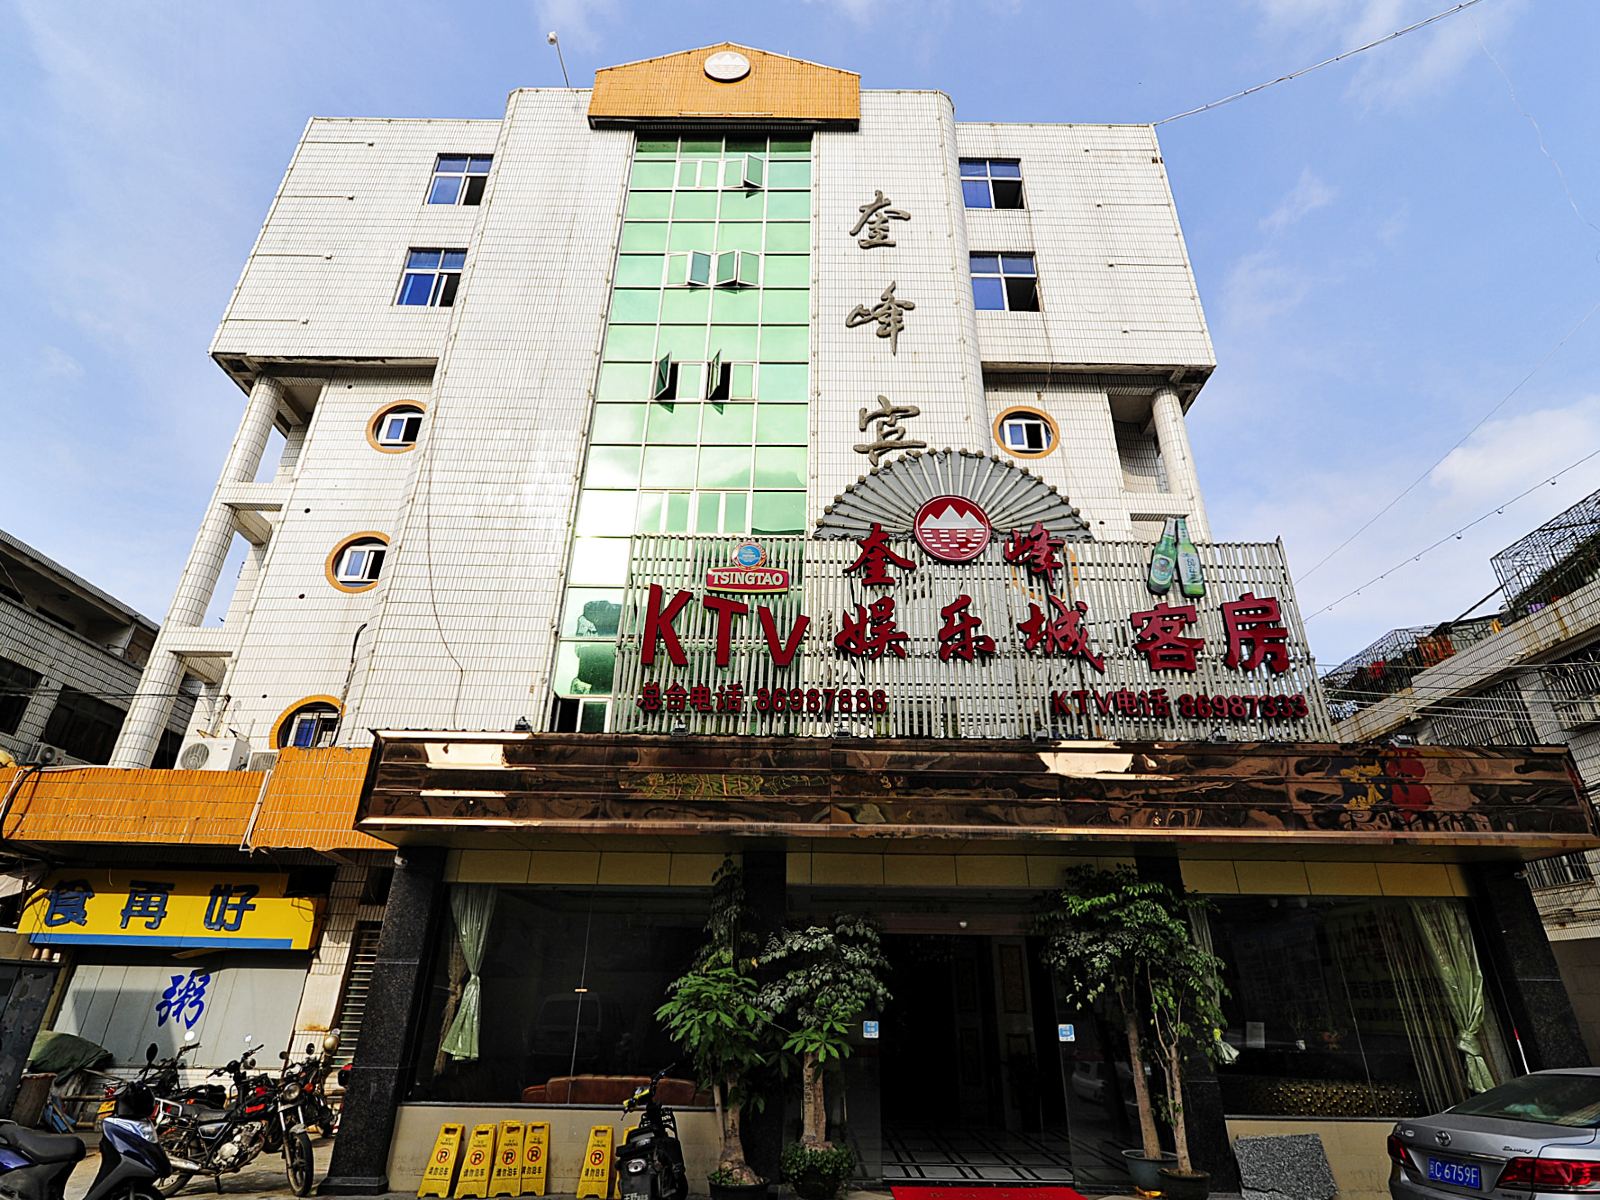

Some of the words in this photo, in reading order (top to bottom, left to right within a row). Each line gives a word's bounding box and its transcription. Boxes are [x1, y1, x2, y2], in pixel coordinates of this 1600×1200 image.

[712, 571, 784, 586] TSINGTAO
[641, 583, 810, 668] KTV
[1129, 591, 1291, 673] 客房
[636, 682, 745, 713] 总台电话
[756, 686, 888, 715] 86987888
[1050, 687, 1170, 718] KTV电话
[1178, 693, 1309, 720] 86987333
